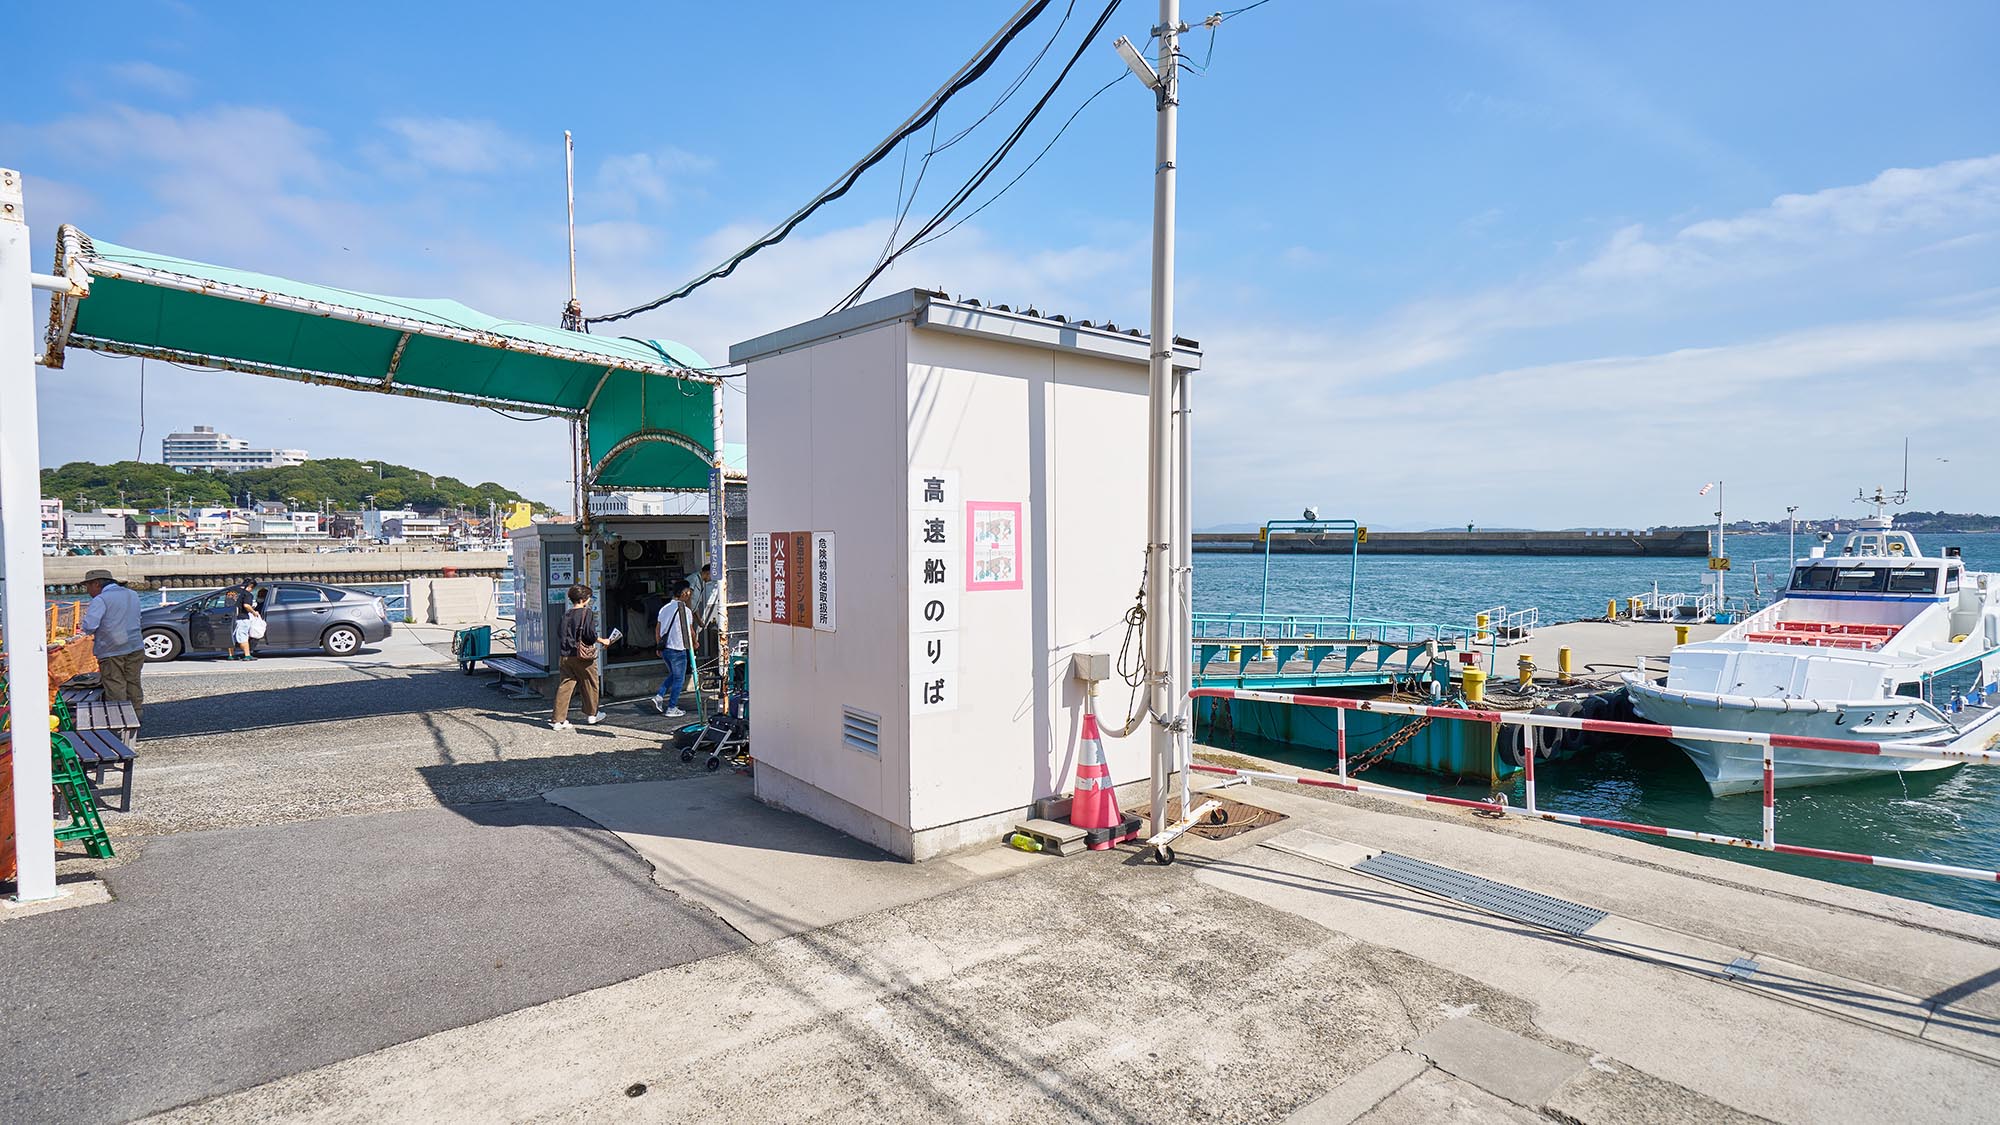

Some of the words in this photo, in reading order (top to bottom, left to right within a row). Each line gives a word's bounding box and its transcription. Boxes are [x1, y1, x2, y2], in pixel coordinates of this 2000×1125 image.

[1358, 529, 1366, 541] 2
[774, 539, 786, 620] 火気厳禁
[797, 536, 805, 623] 給油中エンジン停止
[818, 538, 828, 624] 危険物給油取扱所
[923, 476, 946, 705] 高速船のりば
